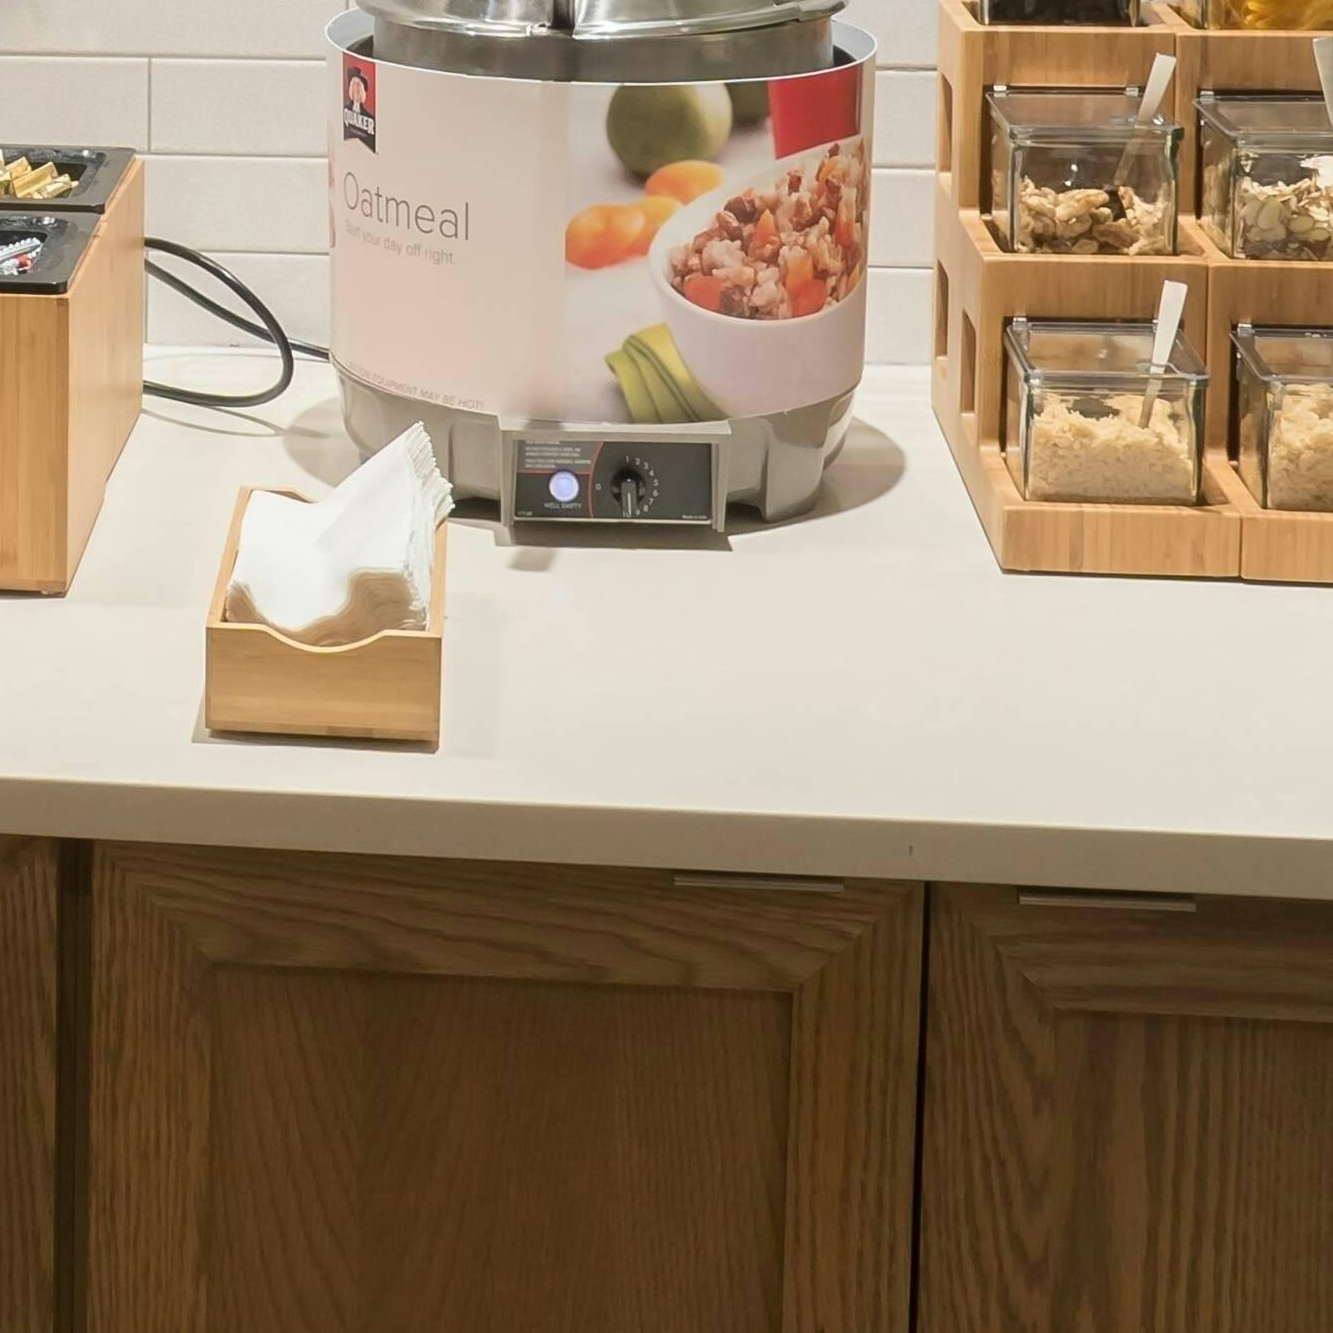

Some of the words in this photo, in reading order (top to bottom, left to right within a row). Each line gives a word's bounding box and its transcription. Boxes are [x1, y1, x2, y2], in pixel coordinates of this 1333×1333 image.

[343, 108, 376, 135] QUAKER
[342, 170, 470, 242] Oatmeal
[361, 230, 382, 250] your
[383, 236, 404, 257] day
[405, 243, 422, 258] off
[424, 247, 458, 266] right.
[420, 388, 441, 402] MAY
[442, 394, 458, 407] BE
